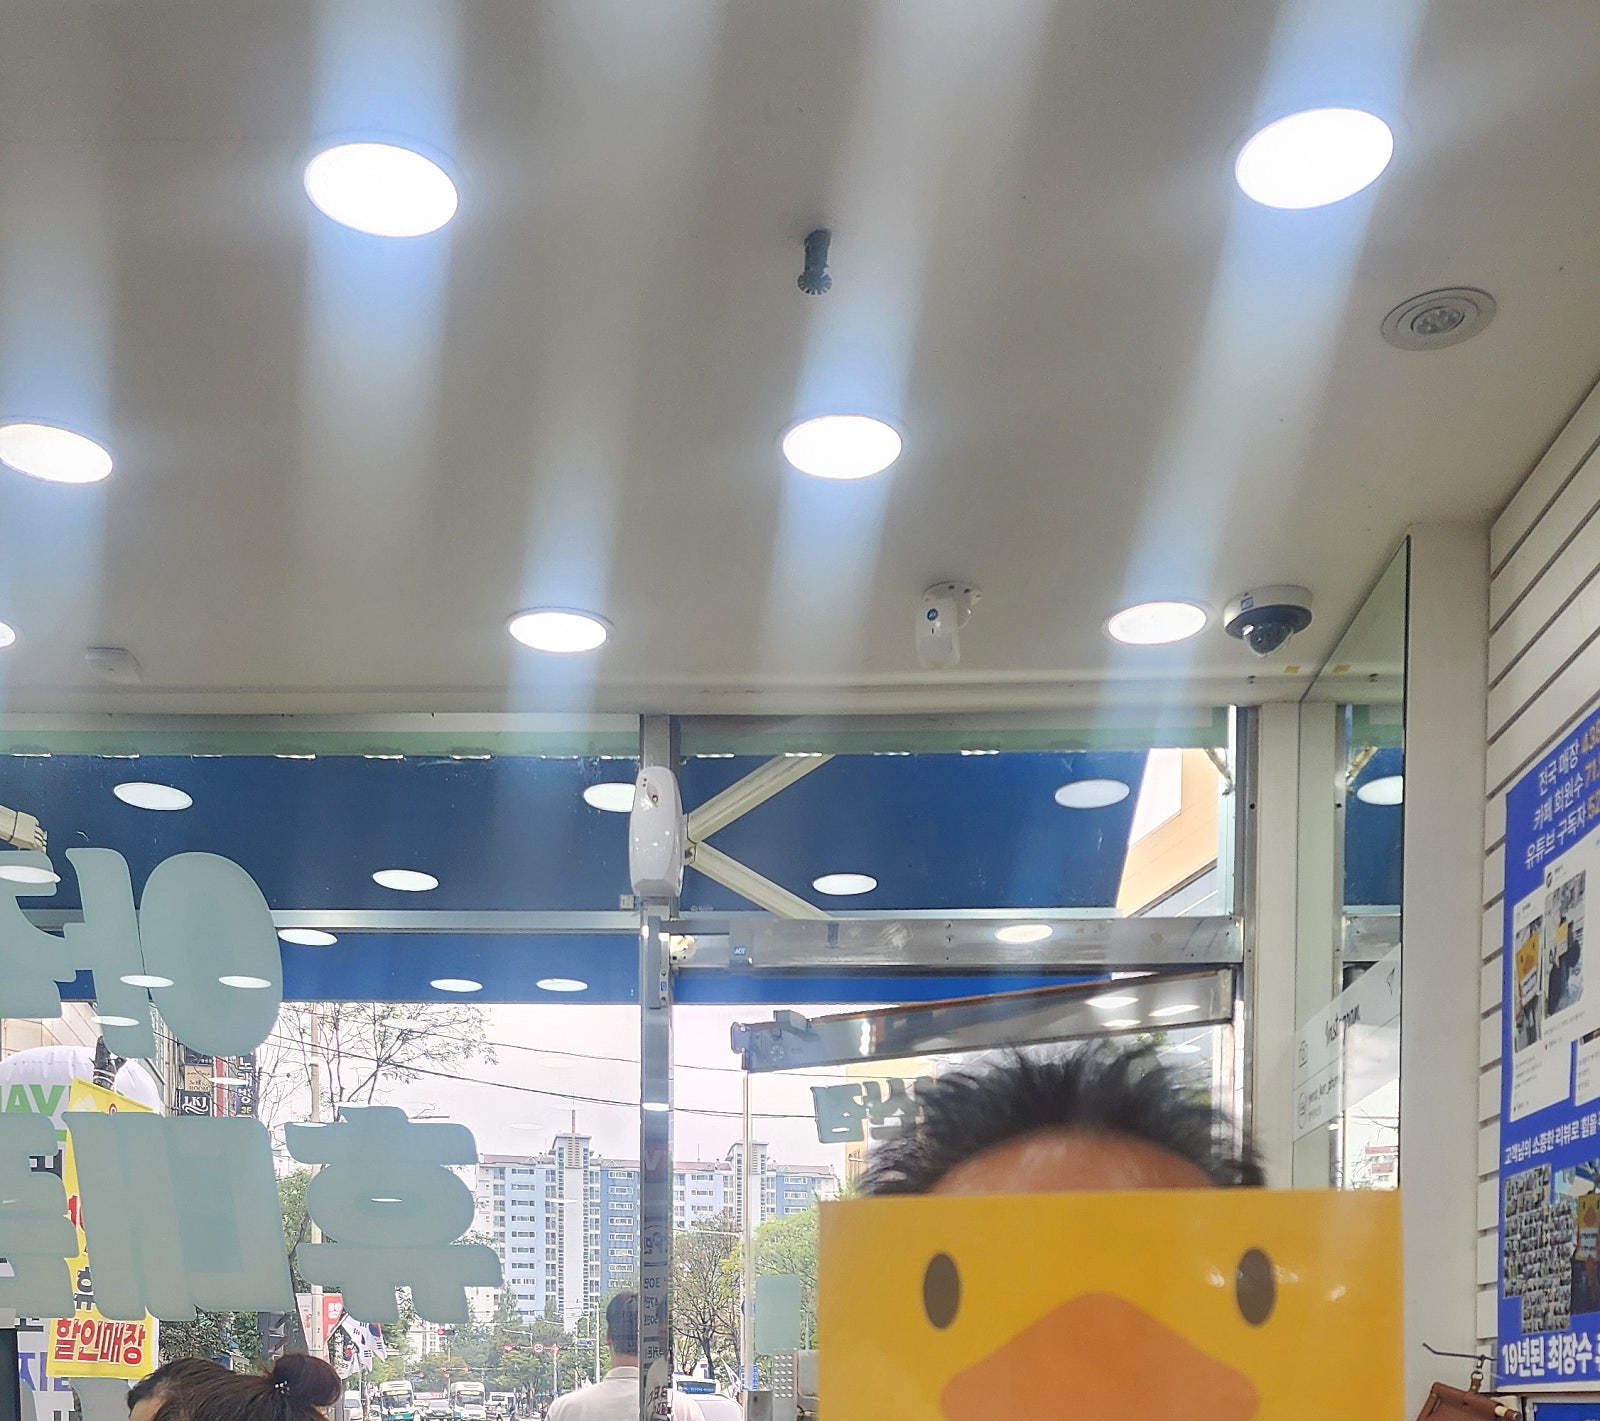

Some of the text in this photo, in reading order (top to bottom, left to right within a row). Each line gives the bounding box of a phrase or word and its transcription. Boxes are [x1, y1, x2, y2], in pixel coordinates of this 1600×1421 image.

[1538, 762, 1557, 796] 전국
[1559, 738, 1580, 774] 매장
[1533, 797, 1553, 831] 카페
[1554, 772, 1585, 812] 회원수
[1525, 828, 1556, 870] 유튜브
[1557, 802, 1587, 845] 구독자
[1504, 1137, 1531, 1165] 고객님의
[1532, 1129, 1554, 1154] 소중한
[1555, 1120, 1579, 1146] 리뷰로
[54, 1317, 146, 1365] 할인매장
[1502, 1337, 1545, 1377] 19년된
[1548, 1332, 1593, 1376] 최장수
